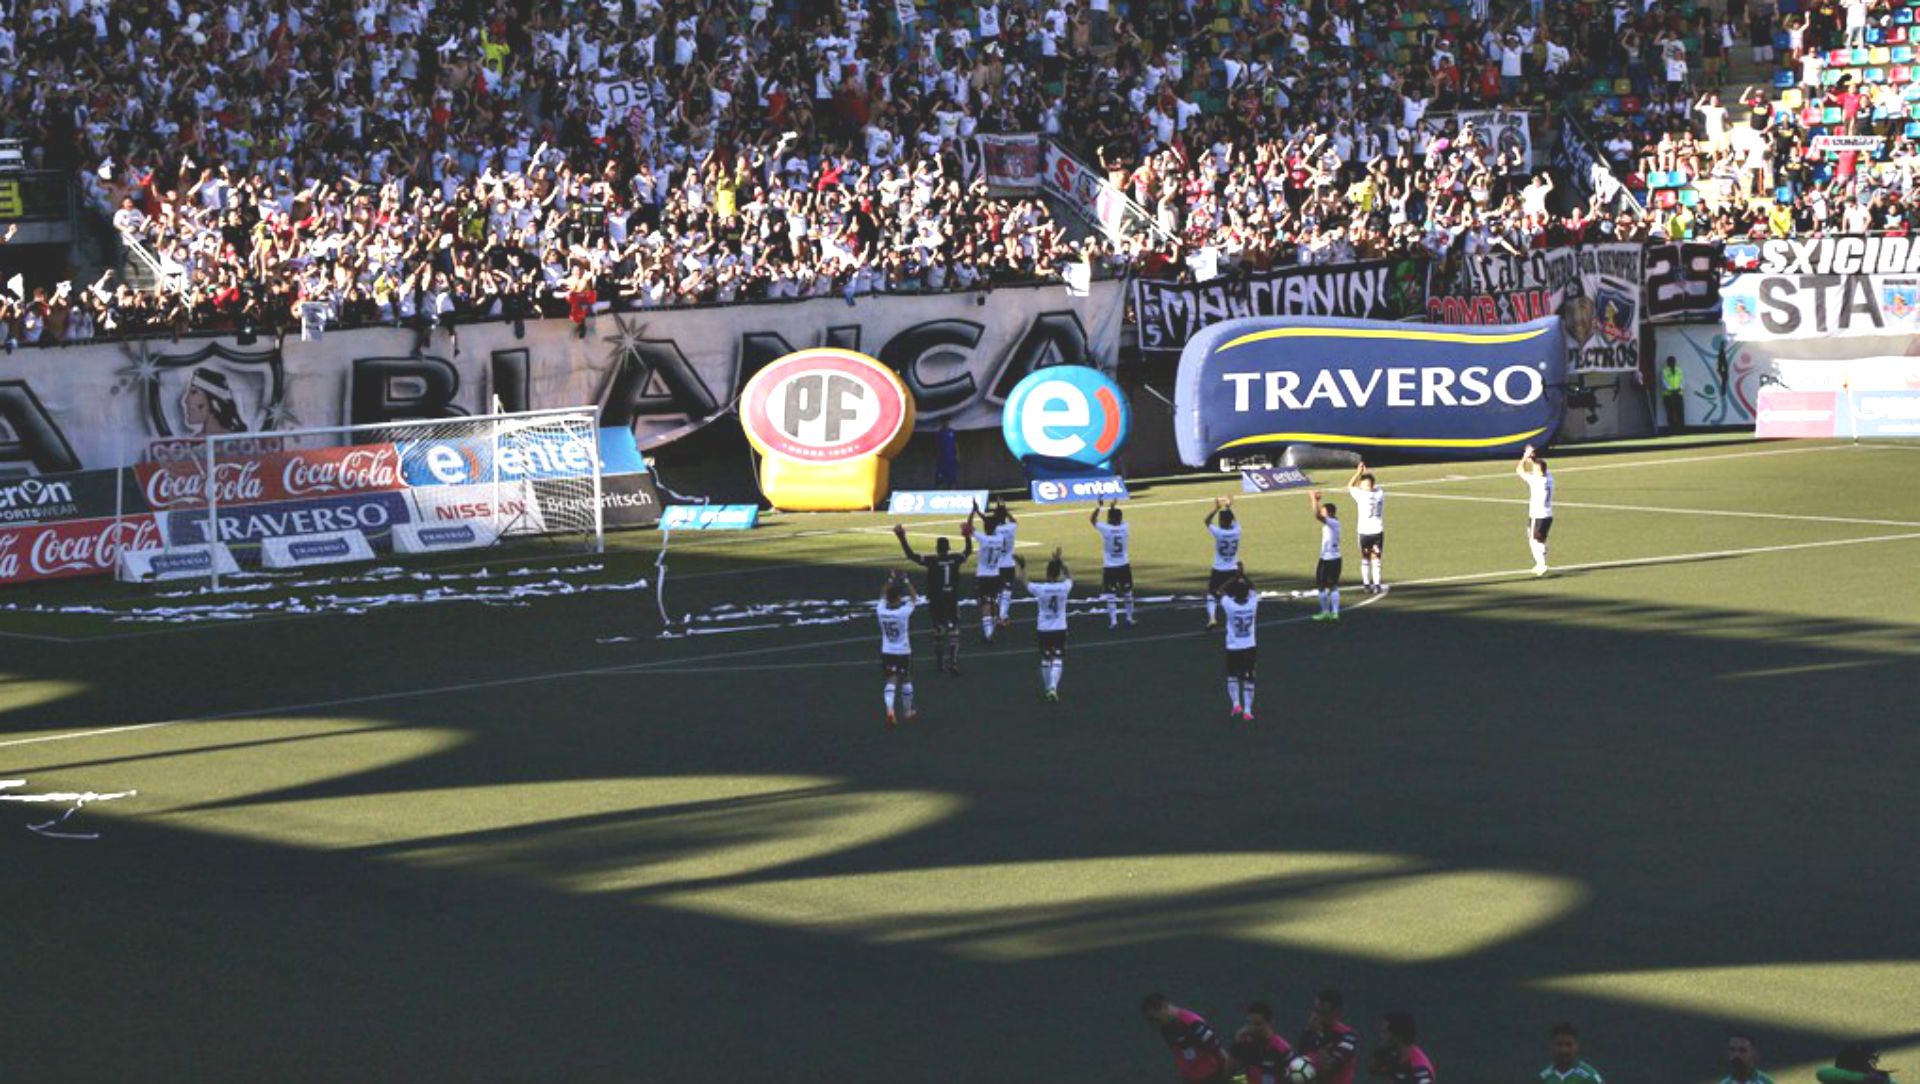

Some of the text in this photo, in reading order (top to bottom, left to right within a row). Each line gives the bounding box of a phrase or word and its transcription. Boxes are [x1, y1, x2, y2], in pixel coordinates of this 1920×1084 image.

[1759, 275, 1885, 335] STA
[1222, 364, 1544, 412] TRAVERSO
[784, 374, 864, 442] PF
[283, 449, 394, 495] Coca-Cola
[500, 437, 606, 475] ente
[1072, 480, 1123, 495] entel
[192, 503, 388, 541] TRAVERSO
[435, 499, 526, 521] NISSAN
[30, 521, 157, 574] Coca-Cola
[1113, 535, 1123, 553] 5
[1048, 595, 1058, 614] 4
